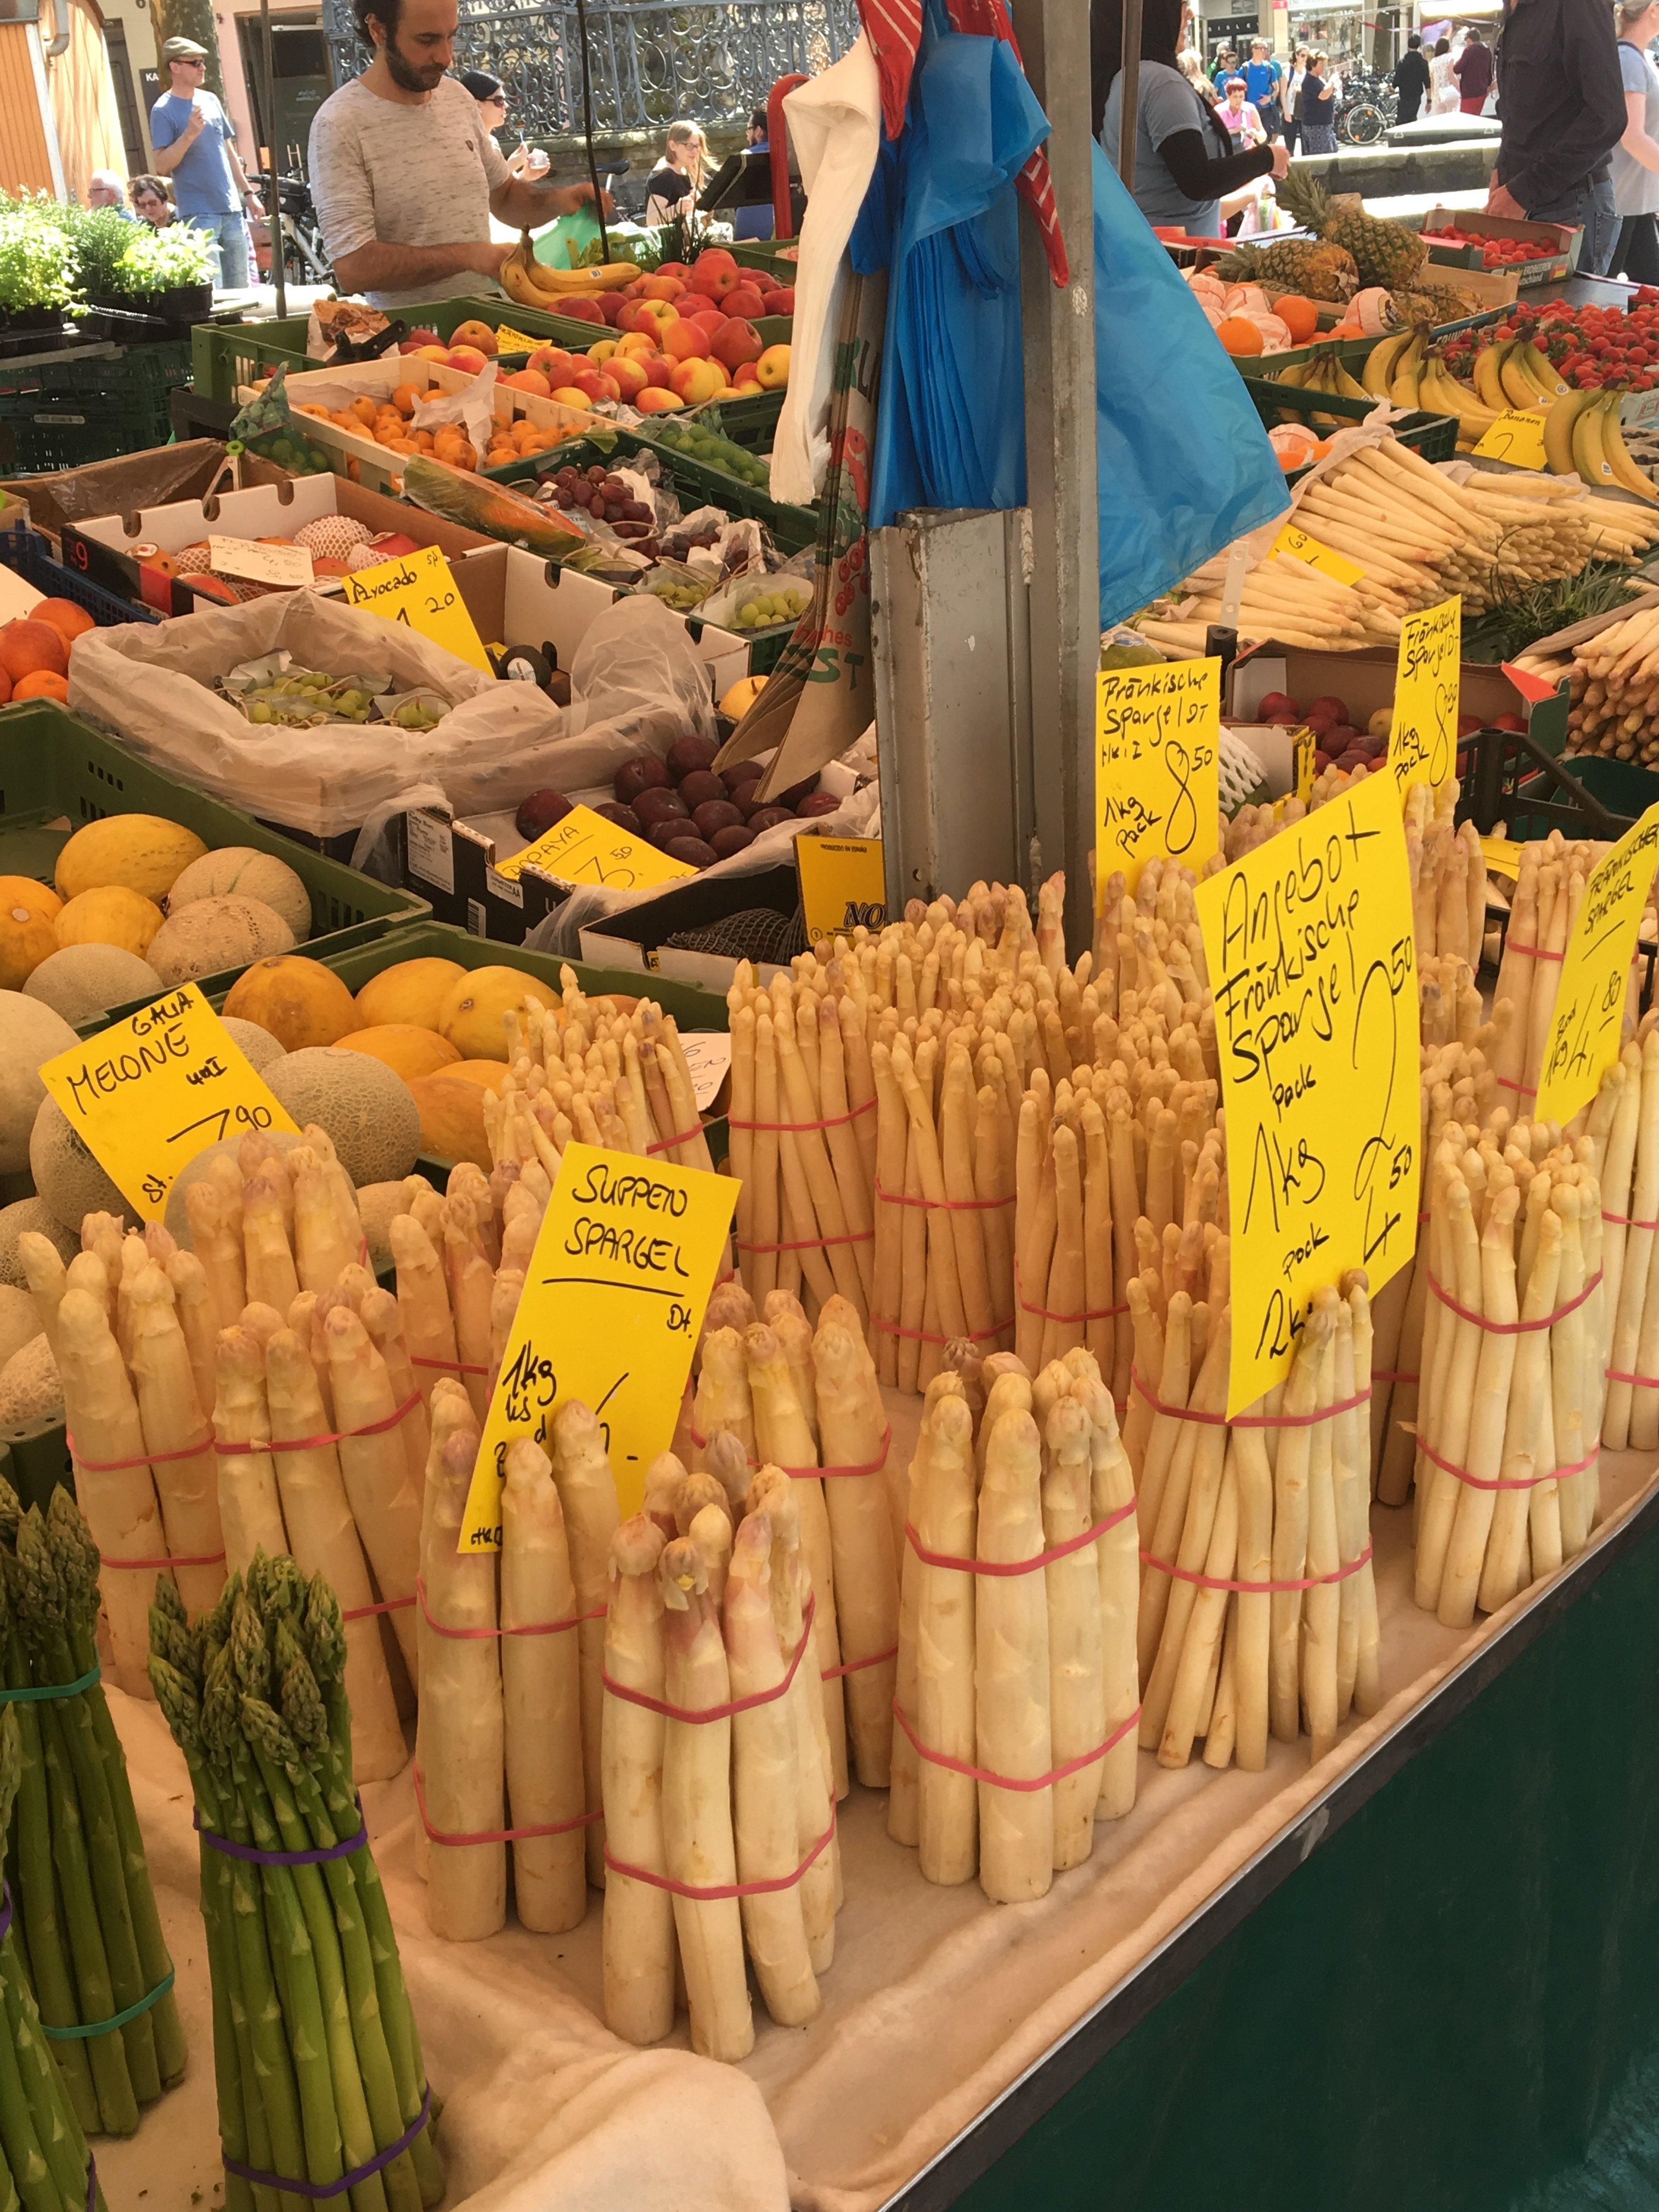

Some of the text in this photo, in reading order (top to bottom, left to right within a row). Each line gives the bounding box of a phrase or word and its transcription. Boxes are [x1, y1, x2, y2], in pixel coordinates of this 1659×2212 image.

[1498, 410, 1541, 426] Bananen
[349, 562, 417, 603] Avocado
[425, 592, 455, 613] 20
[1103, 796, 1144, 827] 1kg
[1222, 799, 1381, 973] Angebot
[66, 1022, 189, 1115] MELONE
[572, 1164, 688, 1217] SUPPEN
[1243, 1122, 1325, 1235] 1kg
[565, 1216, 690, 1277] SPARGEL
[1254, 1289, 1313, 1360] 2k
[502, 1339, 557, 1406] 1kg
